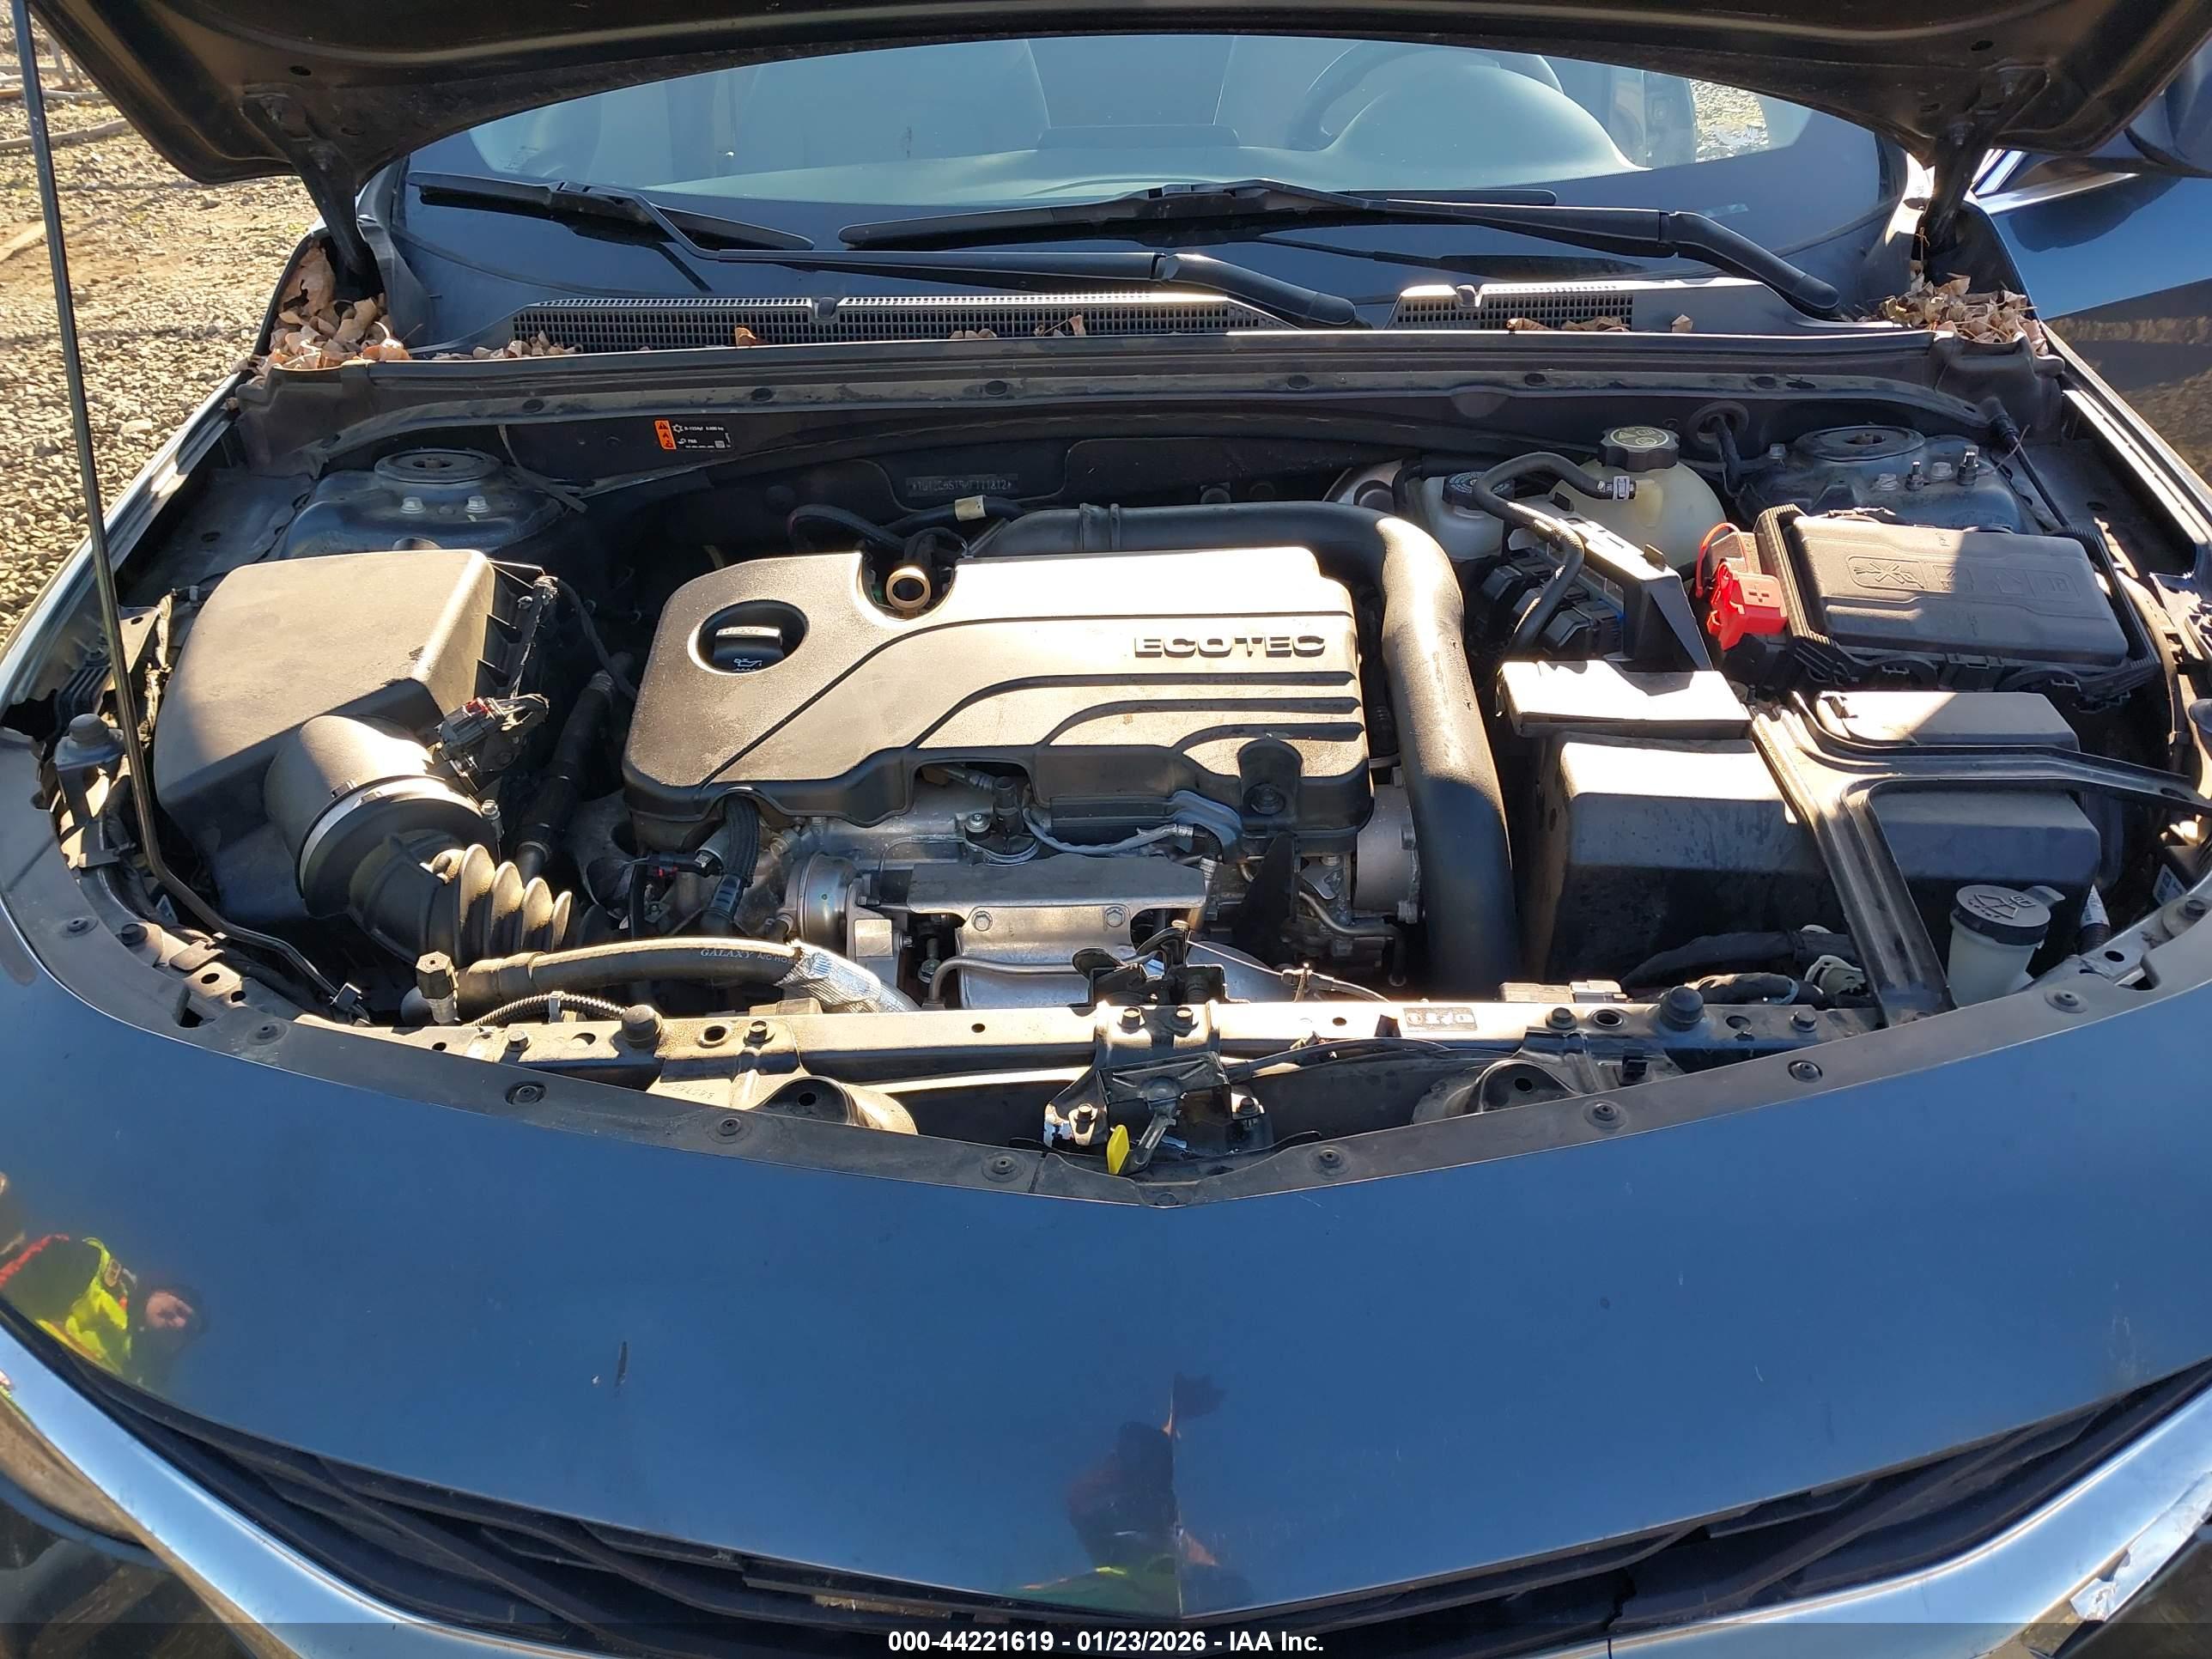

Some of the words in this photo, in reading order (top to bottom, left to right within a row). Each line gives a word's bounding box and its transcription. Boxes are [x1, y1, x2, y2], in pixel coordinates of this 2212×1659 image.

[1133, 634, 1325, 658] ECOTEC
[700, 949, 753, 958] GALAXY
[757, 952, 772, 961] A/C
